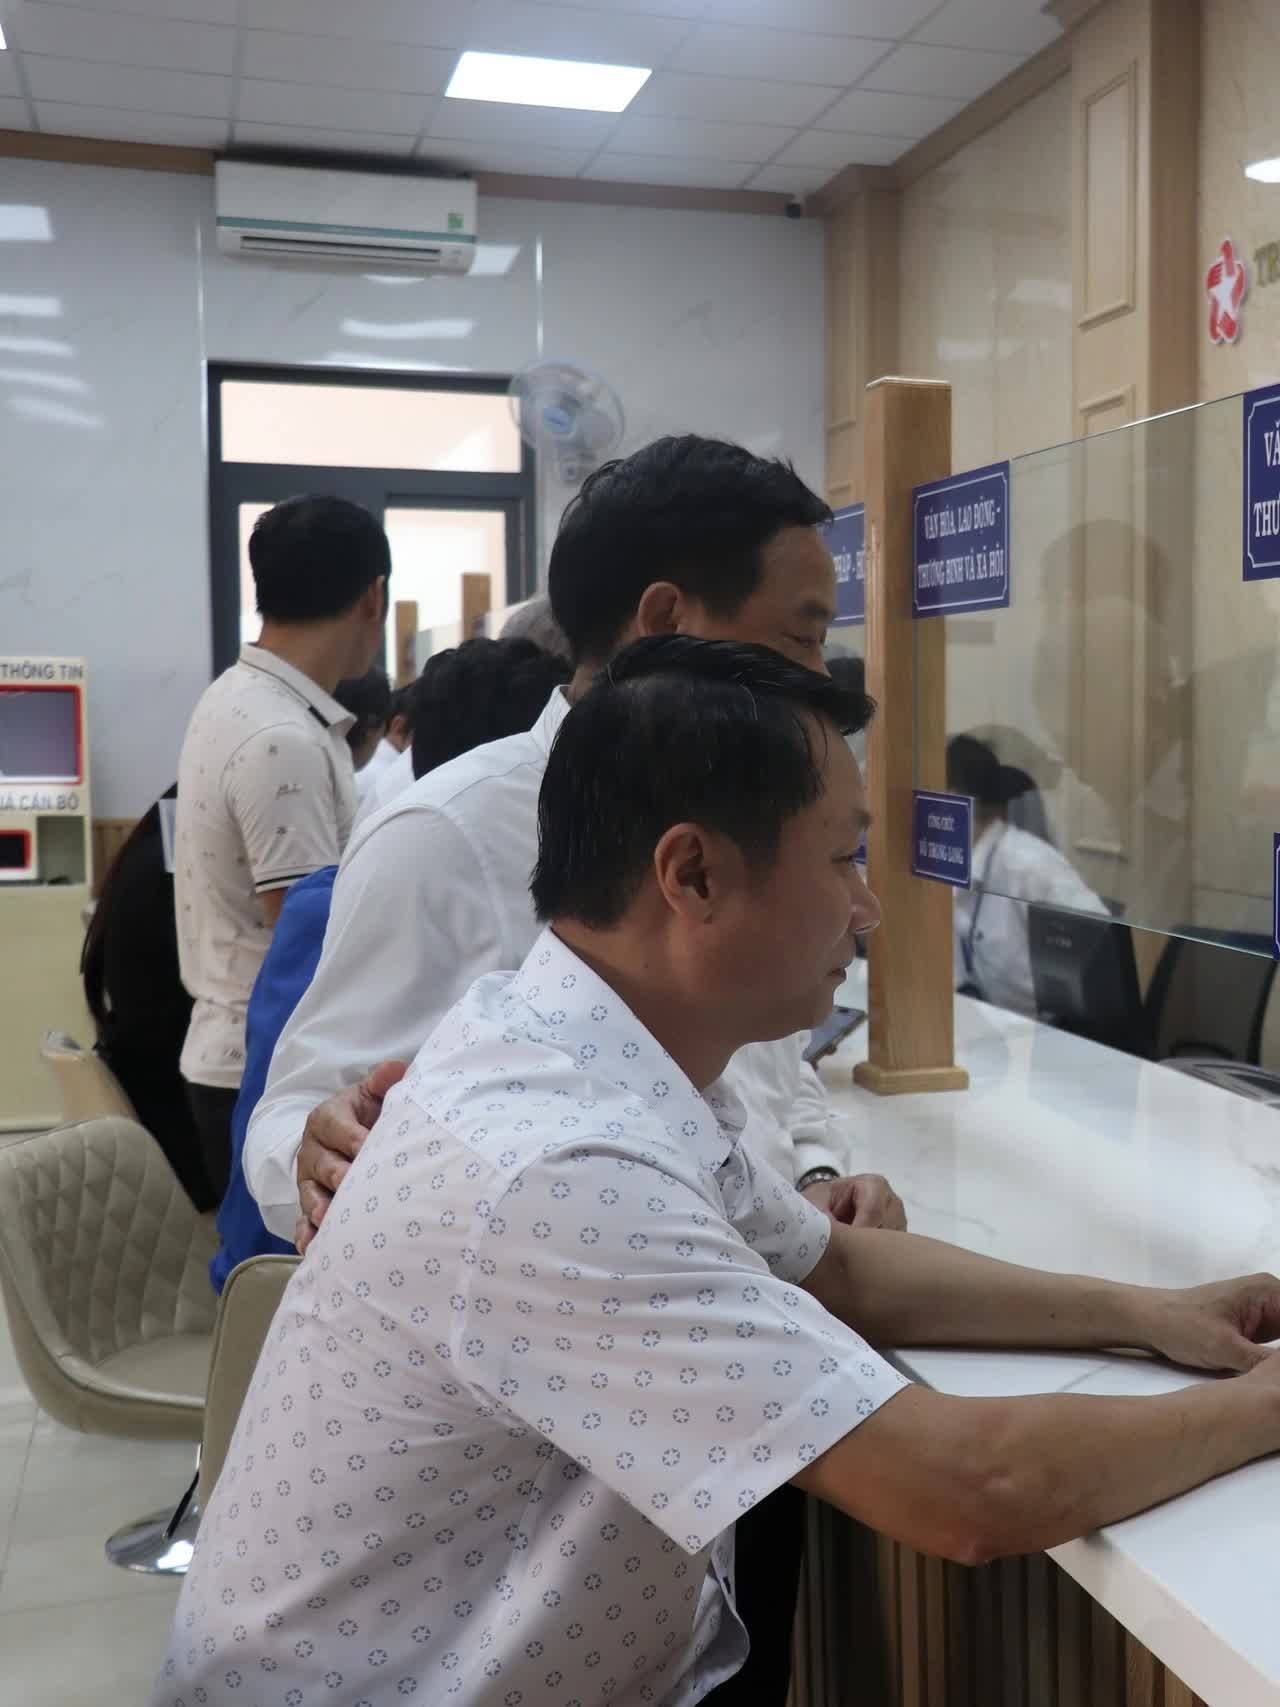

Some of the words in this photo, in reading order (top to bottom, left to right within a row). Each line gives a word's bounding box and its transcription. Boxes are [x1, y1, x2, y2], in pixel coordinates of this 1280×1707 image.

[958, 504, 973, 533] LAO
[946, 556, 964, 585] BINH
[0, 660, 54, 679] THÔNG
[58, 663, 83, 679] TIN
